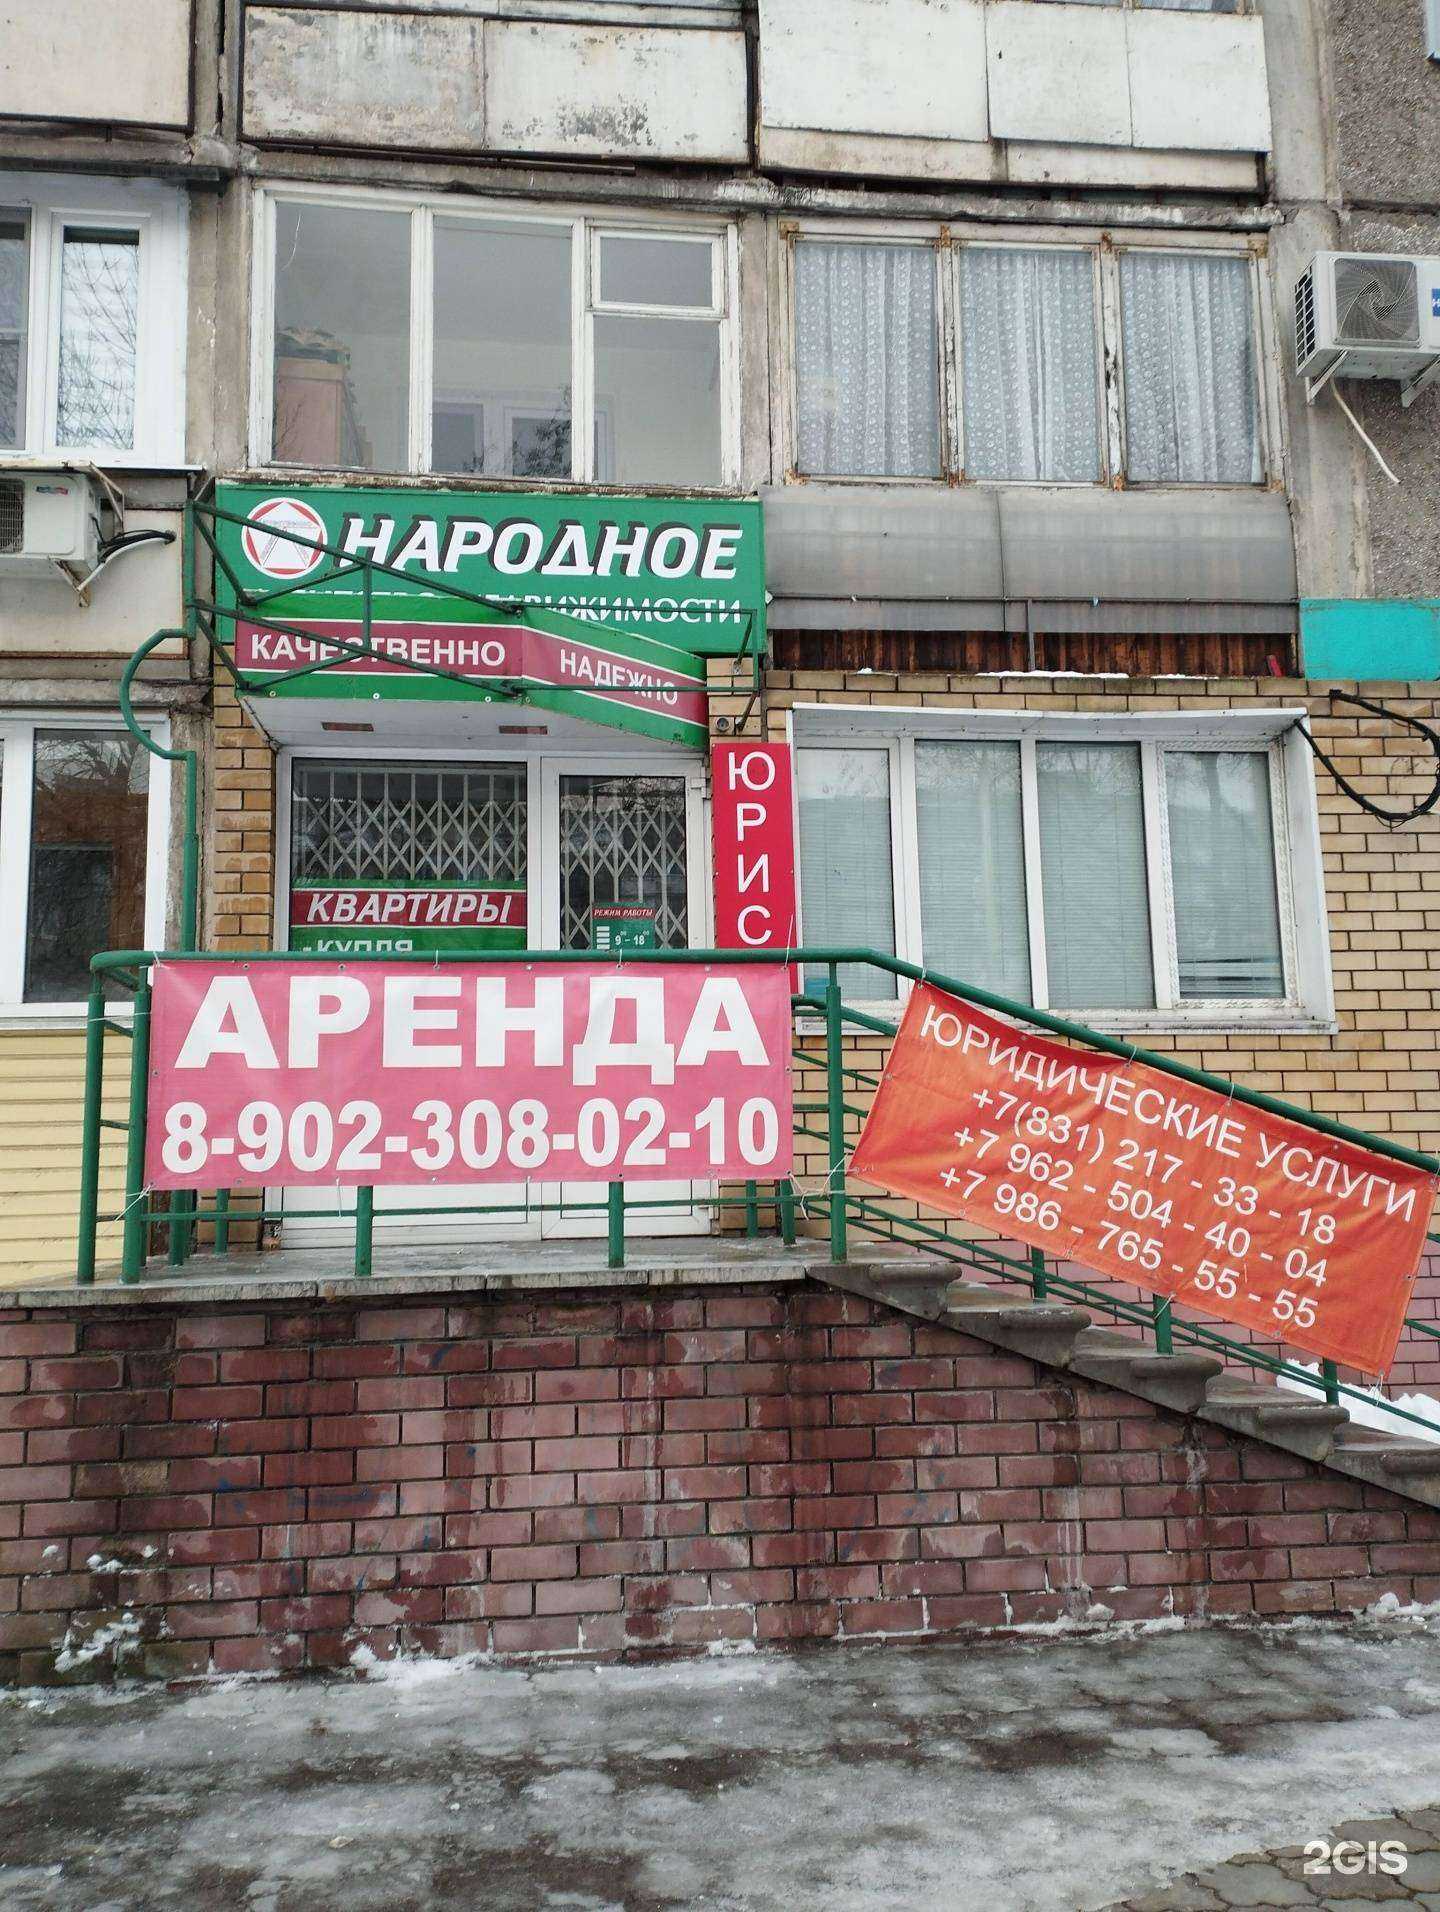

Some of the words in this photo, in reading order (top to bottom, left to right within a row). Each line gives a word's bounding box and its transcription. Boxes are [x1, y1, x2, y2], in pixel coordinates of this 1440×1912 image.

[336, 512, 744, 580] НАРОДНОЕ
[560, 648, 678, 705] НАДЕЖНО
[728, 751, 776, 945] ЮРИС
[306, 893, 512, 923] КВАРТИРЫ
[594, 908, 620, 917] РЕЖИМ
[623, 909, 653, 917] РАБОТЫ
[174, 975, 770, 1086] АРЕНДА
[160, 1096, 780, 1174] 8-902-308-02-10
[920, 1004, 1247, 1158] ЮРИДИЧЕСКИЕ
[1256, 1132, 1417, 1222] УСЛУГИ
[972, 1088, 1105, 1164] +7(831)
[1113, 1138, 1184, 1184] 217
[1213, 1176, 1259, 1216] 33
[1298, 1207, 1336, 1245] 18
[940, 1167, 987, 1200] +7
[993, 1183, 1062, 1231] 986
[1097, 1220, 1164, 1270] 765
[1194, 1259, 1240, 1299] 55
[1272, 1288, 1319, 1328] 55
[954, 1127, 1000, 1159] +7
[1007, 1143, 1074, 1192] 962
[1107, 1180, 1174, 1229] 504
[1204, 1220, 1251, 1258] 40
[1285, 1248, 1328, 1288] 04
